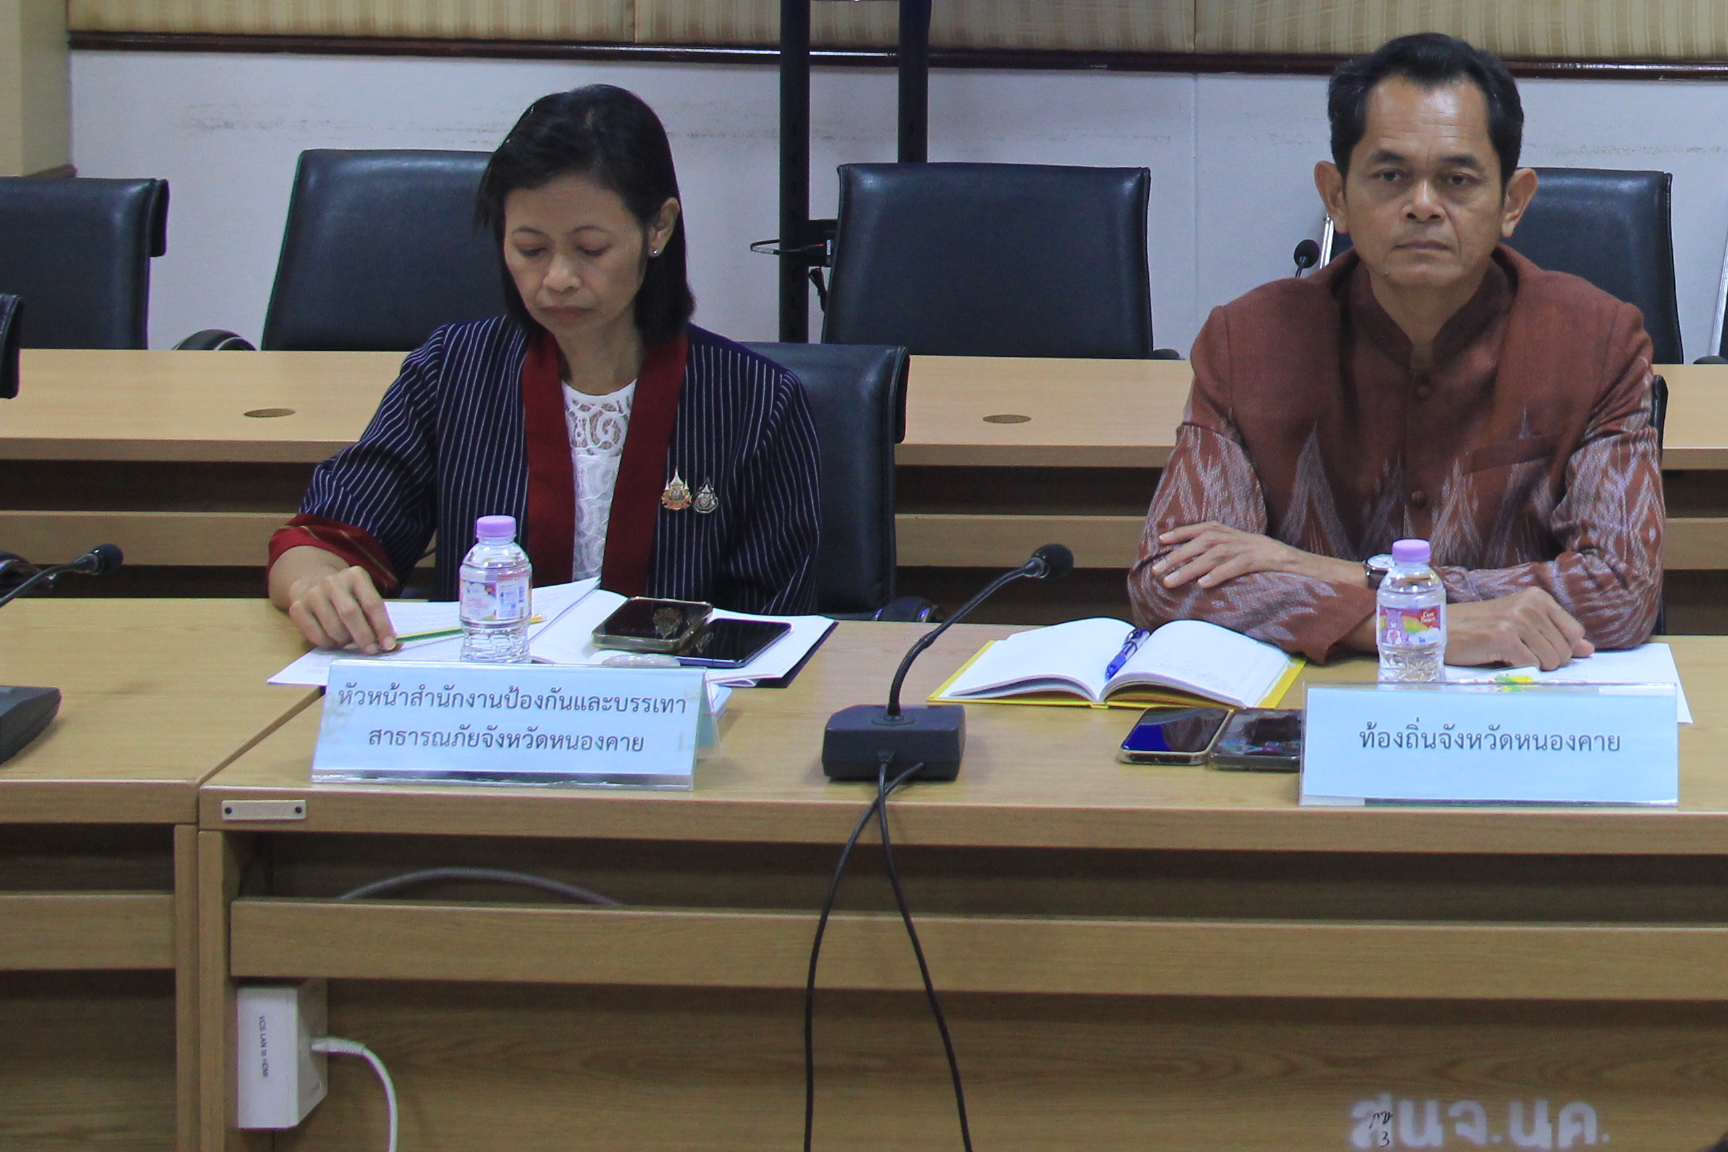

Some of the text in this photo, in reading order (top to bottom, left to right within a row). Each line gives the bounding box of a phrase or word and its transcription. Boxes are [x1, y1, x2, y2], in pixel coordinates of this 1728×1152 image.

[337, 682, 688, 714] หัวหน้าสำนักงานป้องกันและบรรเทา
[368, 723, 645, 752] สาธารณภัยจังหวัดหนองคาย
[1359, 717, 1621, 752] ท้องถิ่นจังหวัดหนองคาย
